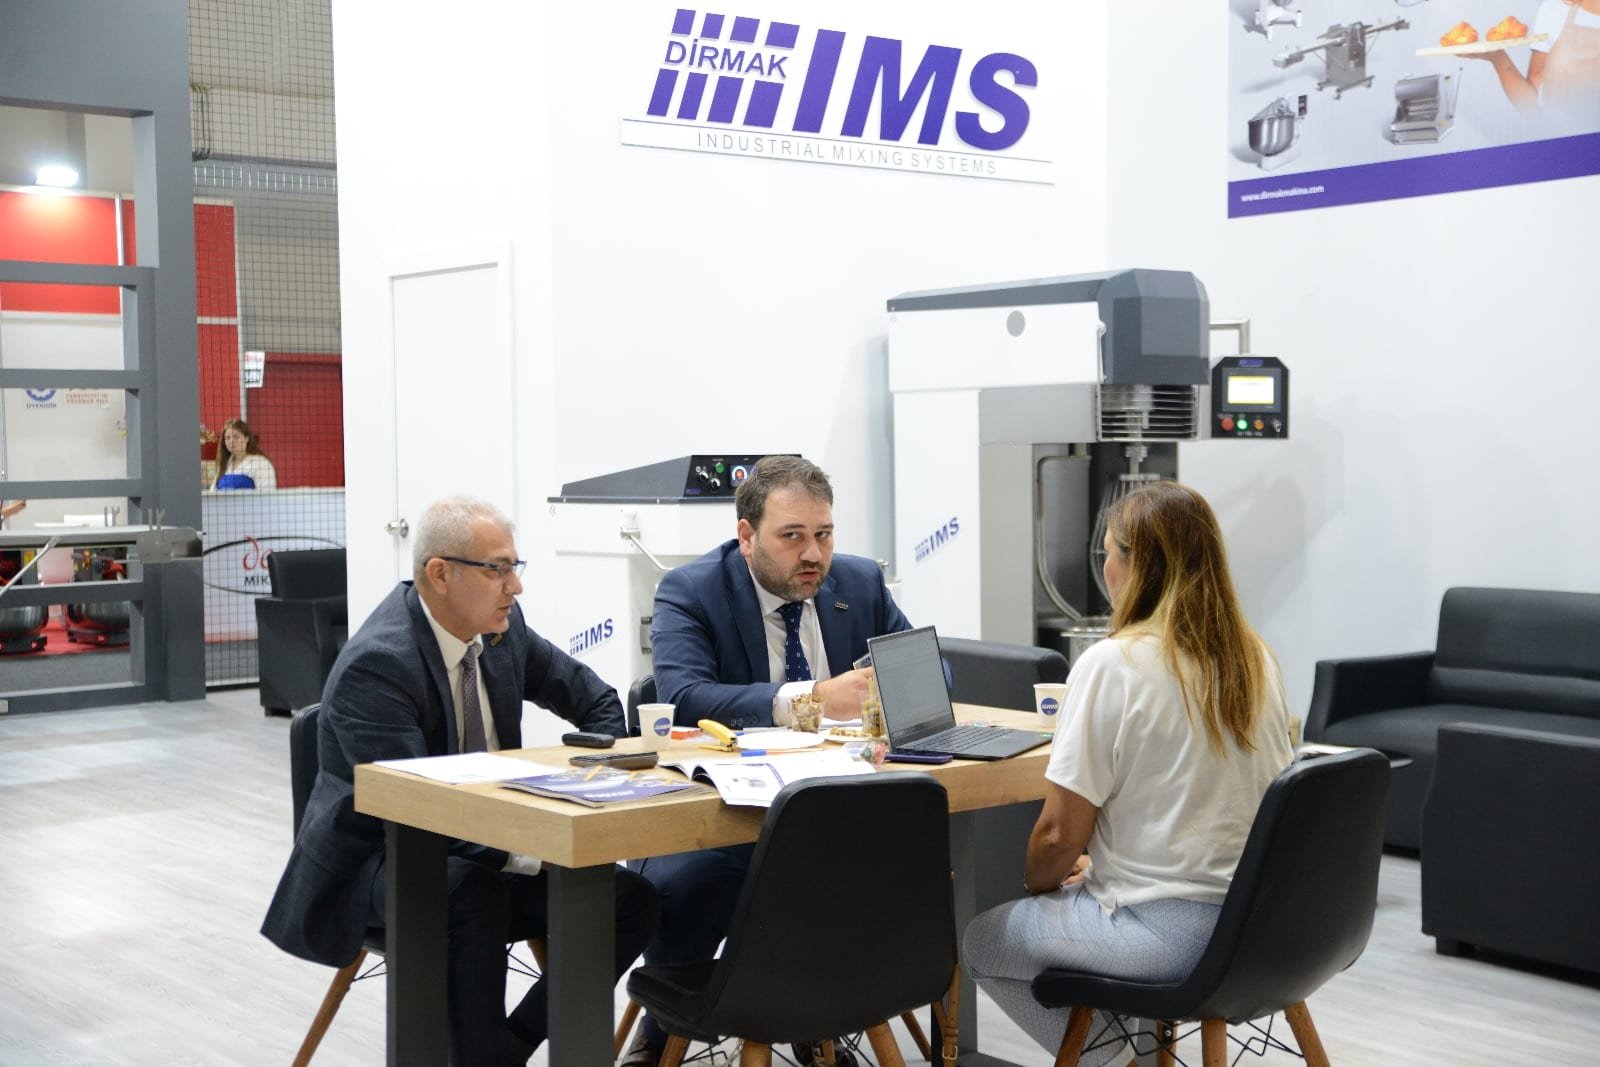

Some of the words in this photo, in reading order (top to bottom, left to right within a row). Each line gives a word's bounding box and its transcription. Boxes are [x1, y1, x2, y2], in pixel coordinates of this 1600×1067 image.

[664, 38, 788, 78] DİRMAK
[792, 28, 1038, 151] IMS
[698, 132, 824, 159] INDUSTRIAL
[832, 145, 902, 166] MIXING
[911, 153, 996, 175] SYSTEMS
[929, 516, 960, 552] IMS
[584, 618, 613, 650] IMS
